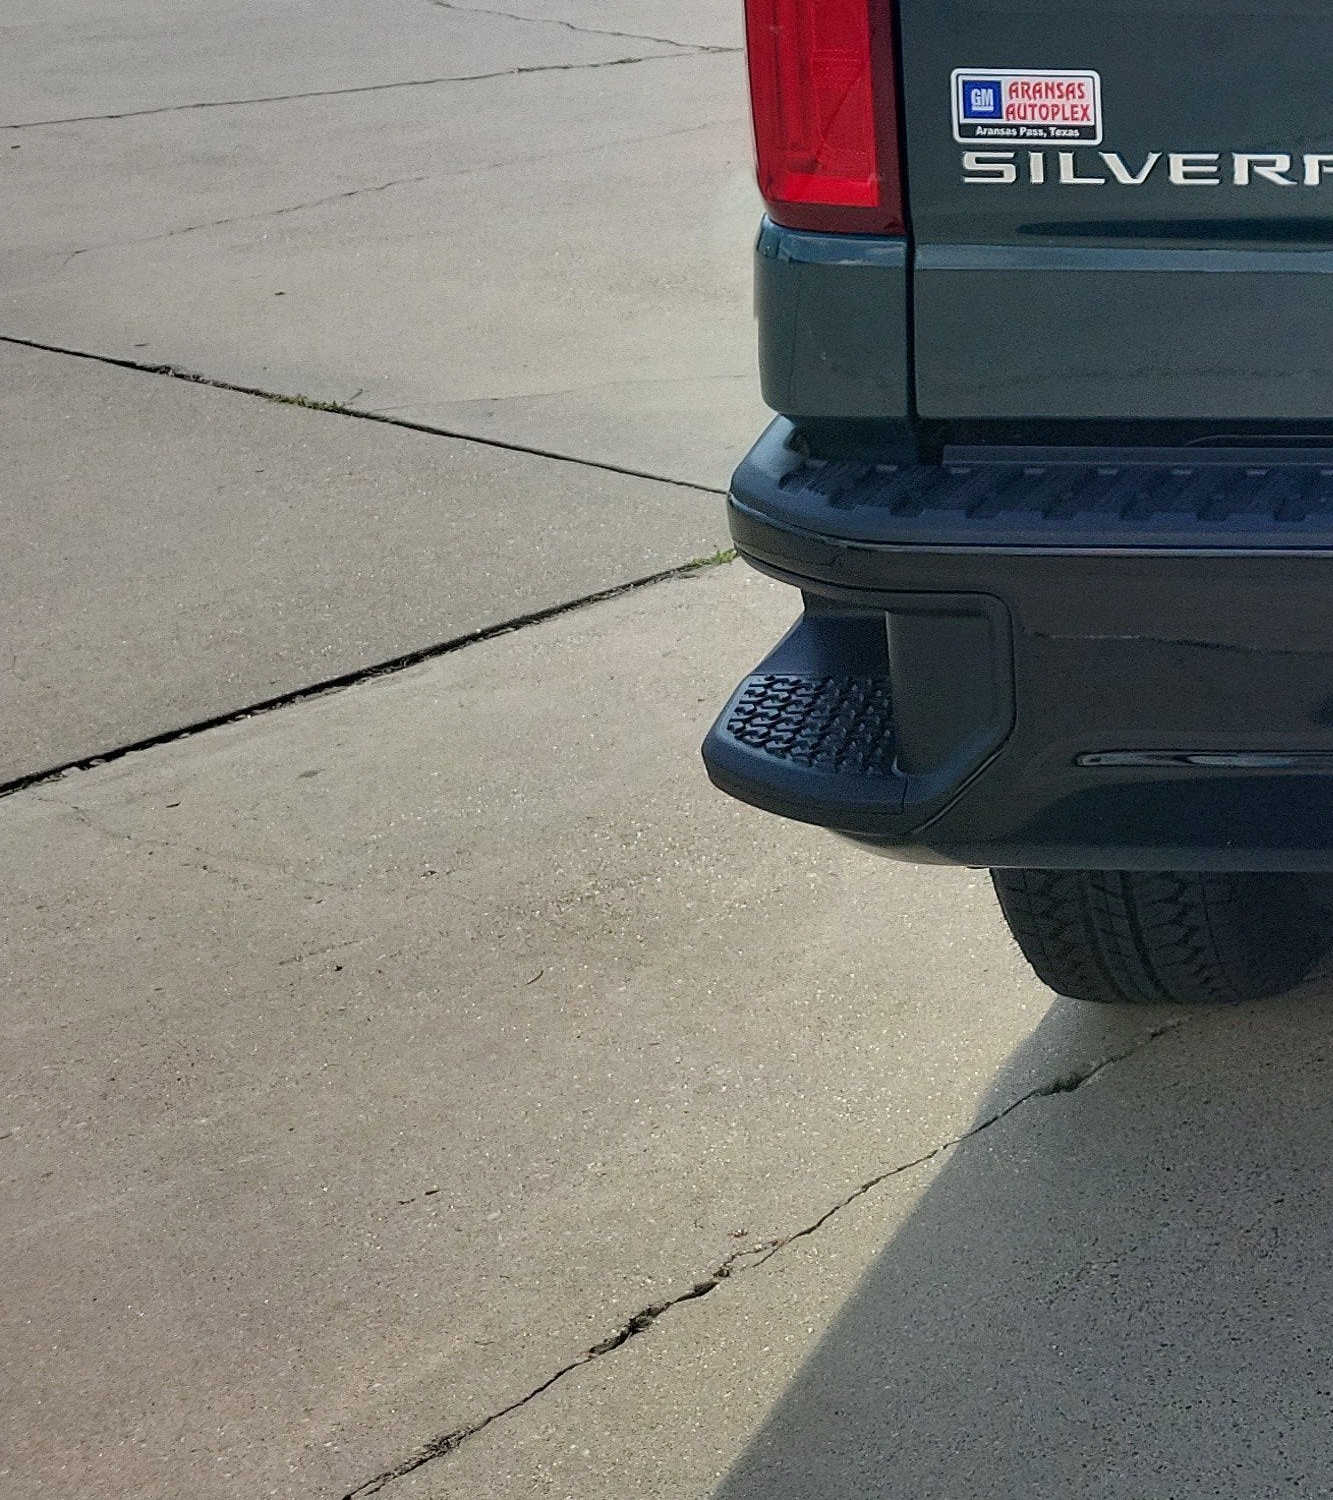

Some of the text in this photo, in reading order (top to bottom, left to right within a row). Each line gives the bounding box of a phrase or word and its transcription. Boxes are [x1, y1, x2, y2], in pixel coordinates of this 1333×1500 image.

[971, 88, 994, 107] GM
[1008, 81, 1086, 100] ARANSAS
[1005, 103, 1091, 122] AUTOPLEX
[975, 125, 1080, 138] Aransas Pass, Texas
